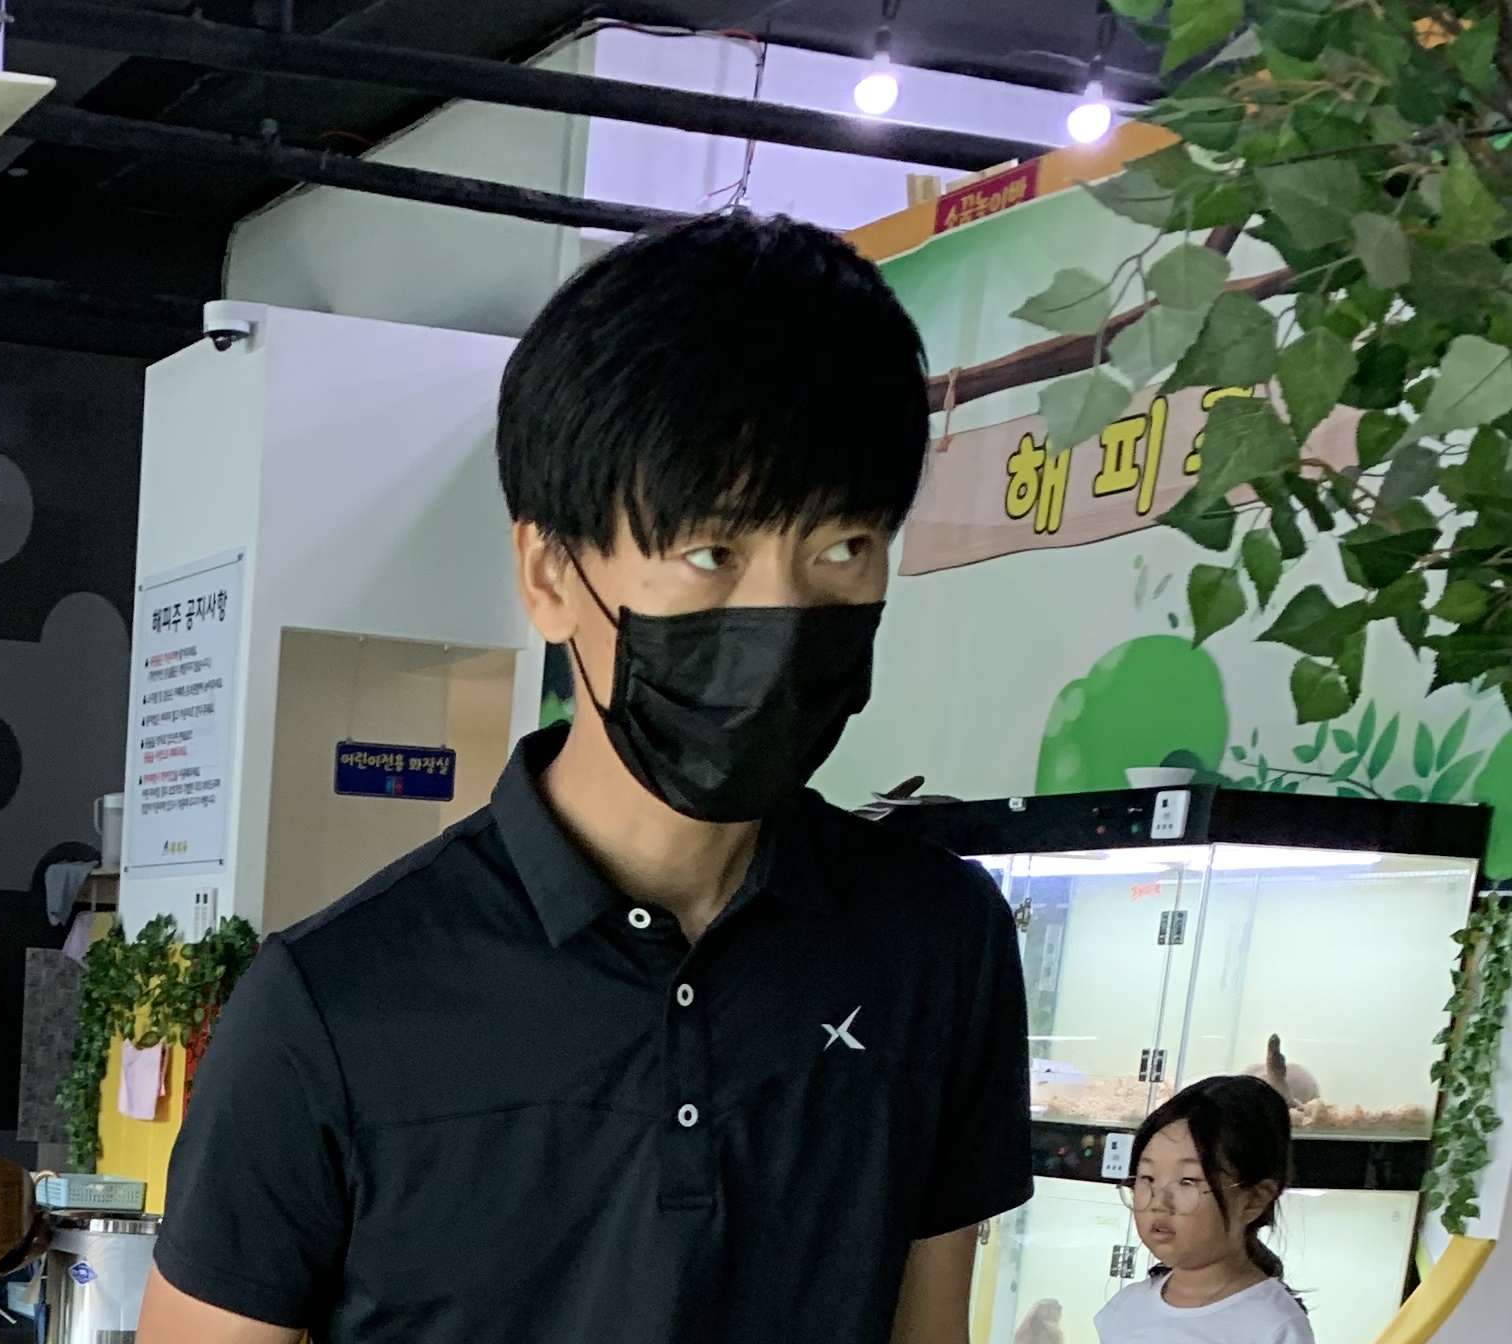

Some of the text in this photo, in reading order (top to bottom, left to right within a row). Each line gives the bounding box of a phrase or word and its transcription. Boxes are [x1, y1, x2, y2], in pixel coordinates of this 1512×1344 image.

[152, 589, 228, 633] 해피주 공지사항
[341, 752, 449, 775] 어린이전용 화장실
